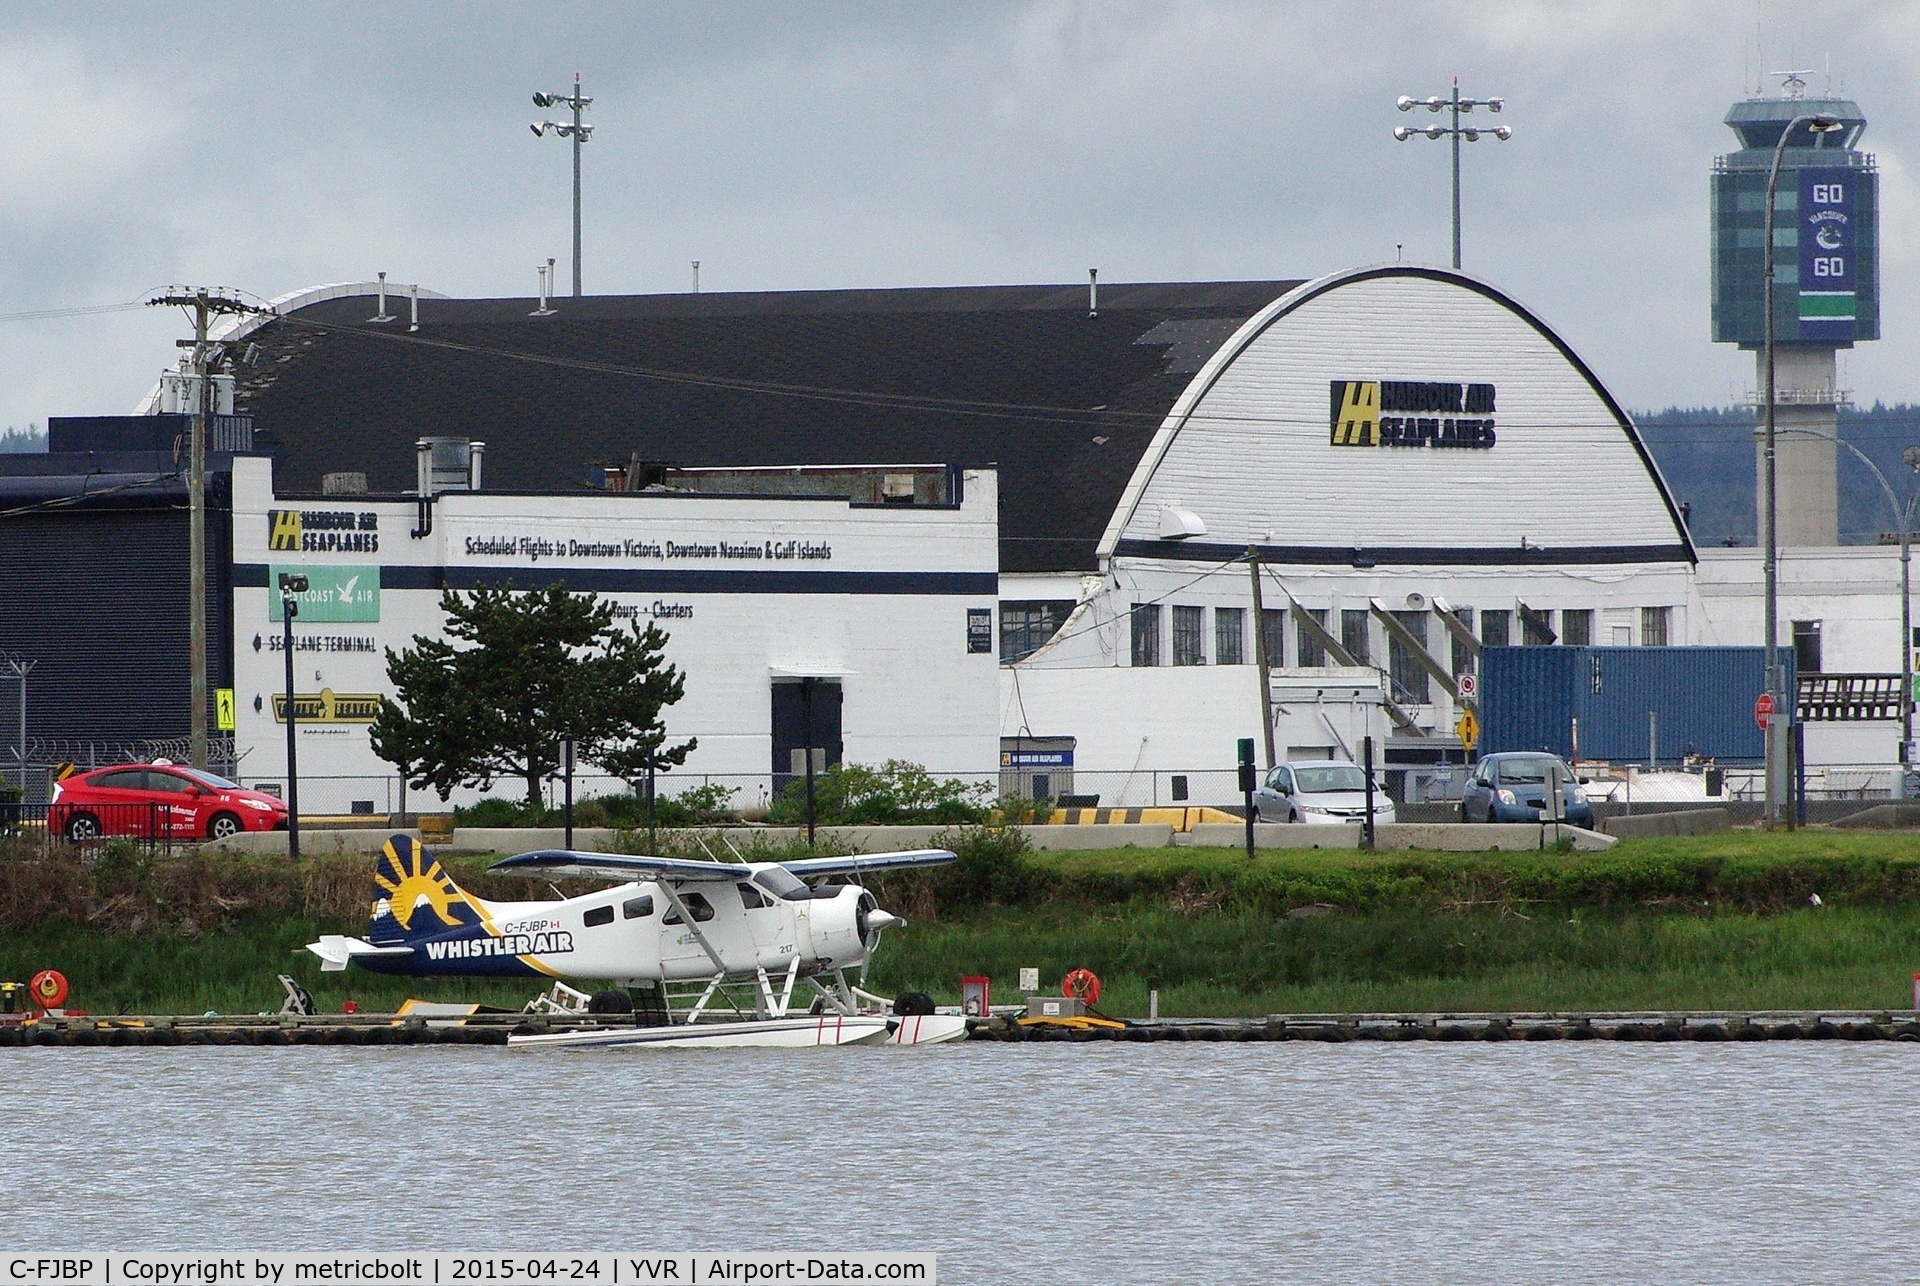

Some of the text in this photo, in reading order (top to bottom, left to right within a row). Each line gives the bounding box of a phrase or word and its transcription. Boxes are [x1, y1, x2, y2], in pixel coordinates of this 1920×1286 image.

[1813, 184, 1843, 203] GO
[1808, 210, 1848, 225] VANCOUVER
[1814, 257, 1844, 276] GO
[1381, 381, 1497, 413] HARBOUR AIR
[1380, 416, 1496, 449] SEAPLANES
[301, 511, 378, 530] HARBOUR AIR
[302, 532, 379, 553] SEAPLANES
[465, 535, 832, 562] Scheduled Flights to Downtown Victoria, Downtown Nanaimo & Gulf Islands
[280, 589, 373, 602] STCOAST AIR
[612, 600, 694, 618] ours Charters
[325, 636, 377, 652] TERMINAL
[1758, 702, 1772, 712] STOP
[504, 920, 548, 934] C-FJBP
[425, 931, 573, 961] WHISTLER AIR
[779, 944, 794, 955] 217
